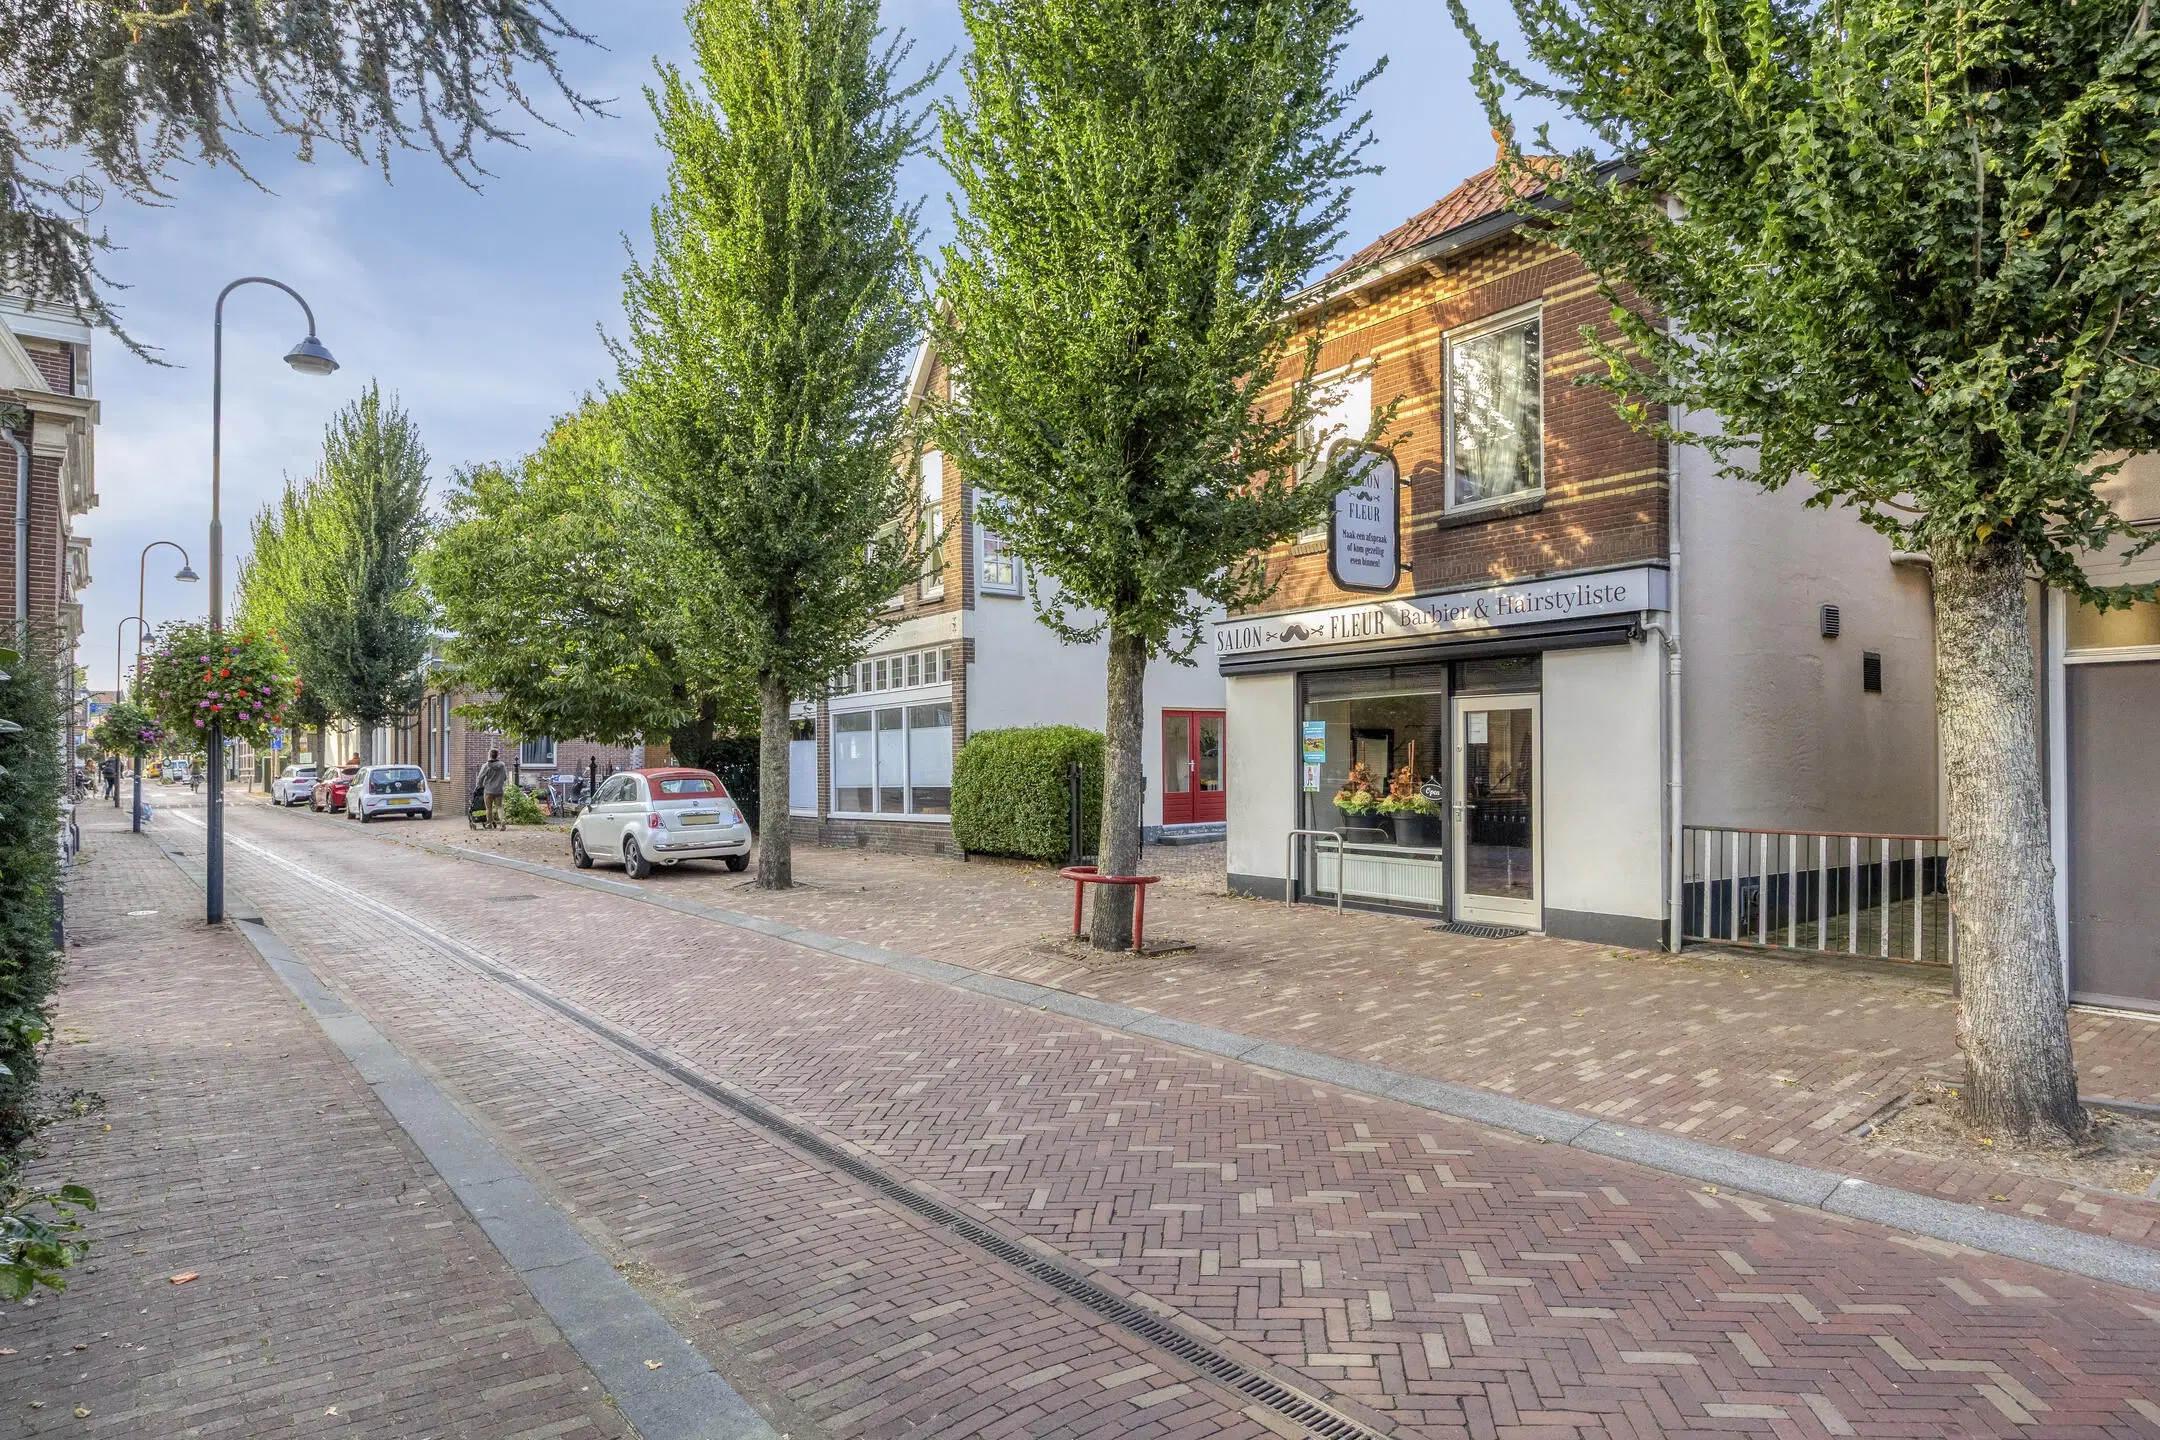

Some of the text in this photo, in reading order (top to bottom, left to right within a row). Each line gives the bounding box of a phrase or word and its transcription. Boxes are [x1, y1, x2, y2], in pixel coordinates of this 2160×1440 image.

[1349, 502, 1380, 522] FLEUR
[1342, 529, 1387, 545] Maak een afspraak
[1347, 542, 1384, 558] of kom gezellig
[1350, 557, 1361, 566] even
[1217, 584, 1627, 651] SALON FLEUR Barbier & Hairstyliste
[1425, 787, 1440, 796] Open
